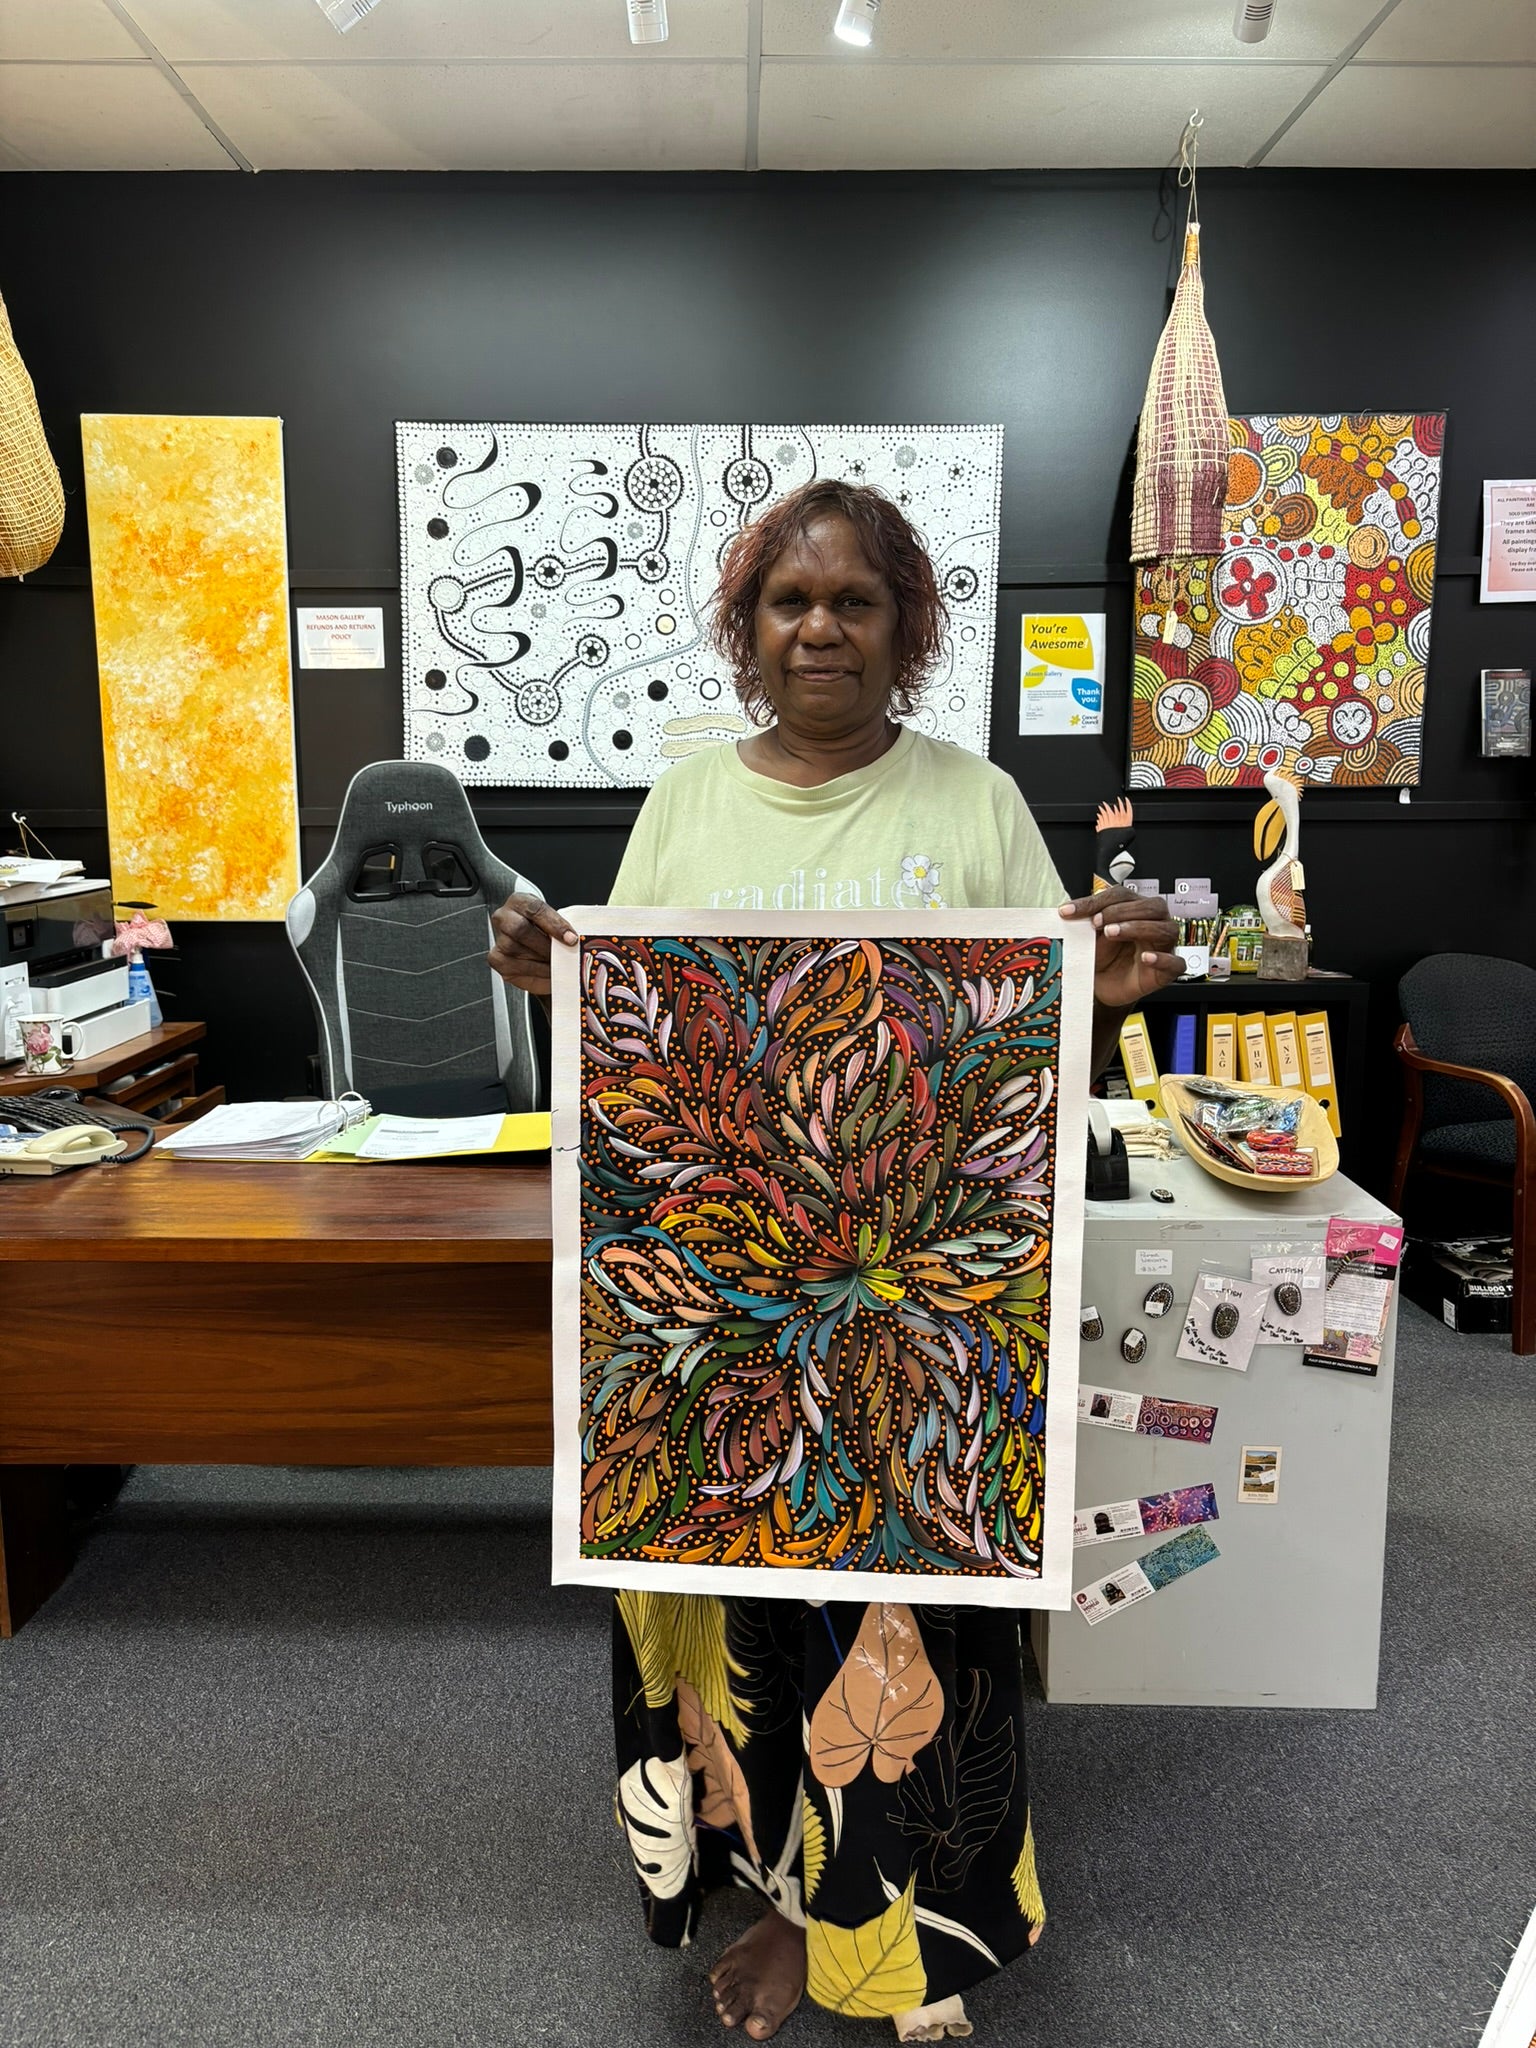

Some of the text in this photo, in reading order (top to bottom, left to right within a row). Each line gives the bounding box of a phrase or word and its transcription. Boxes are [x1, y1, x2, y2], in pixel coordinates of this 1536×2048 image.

[1031, 624, 1068, 634] You're
[1077, 687, 1100, 696] Thank
[384, 801, 433, 814] Typhoon
[708, 867, 921, 910] radiate
[1219, 1049, 1226, 1057] A
[1283, 1045, 1290, 1053] N
[1253, 1050, 1260, 1058] H
[1218, 1060, 1226, 1068] G
[1284, 1056, 1292, 1064] Z
[1254, 1061, 1263, 1069] M
[1468, 1284, 1505, 1292] BULLDOG
[1215, 1287, 1242, 1299] TFISH
